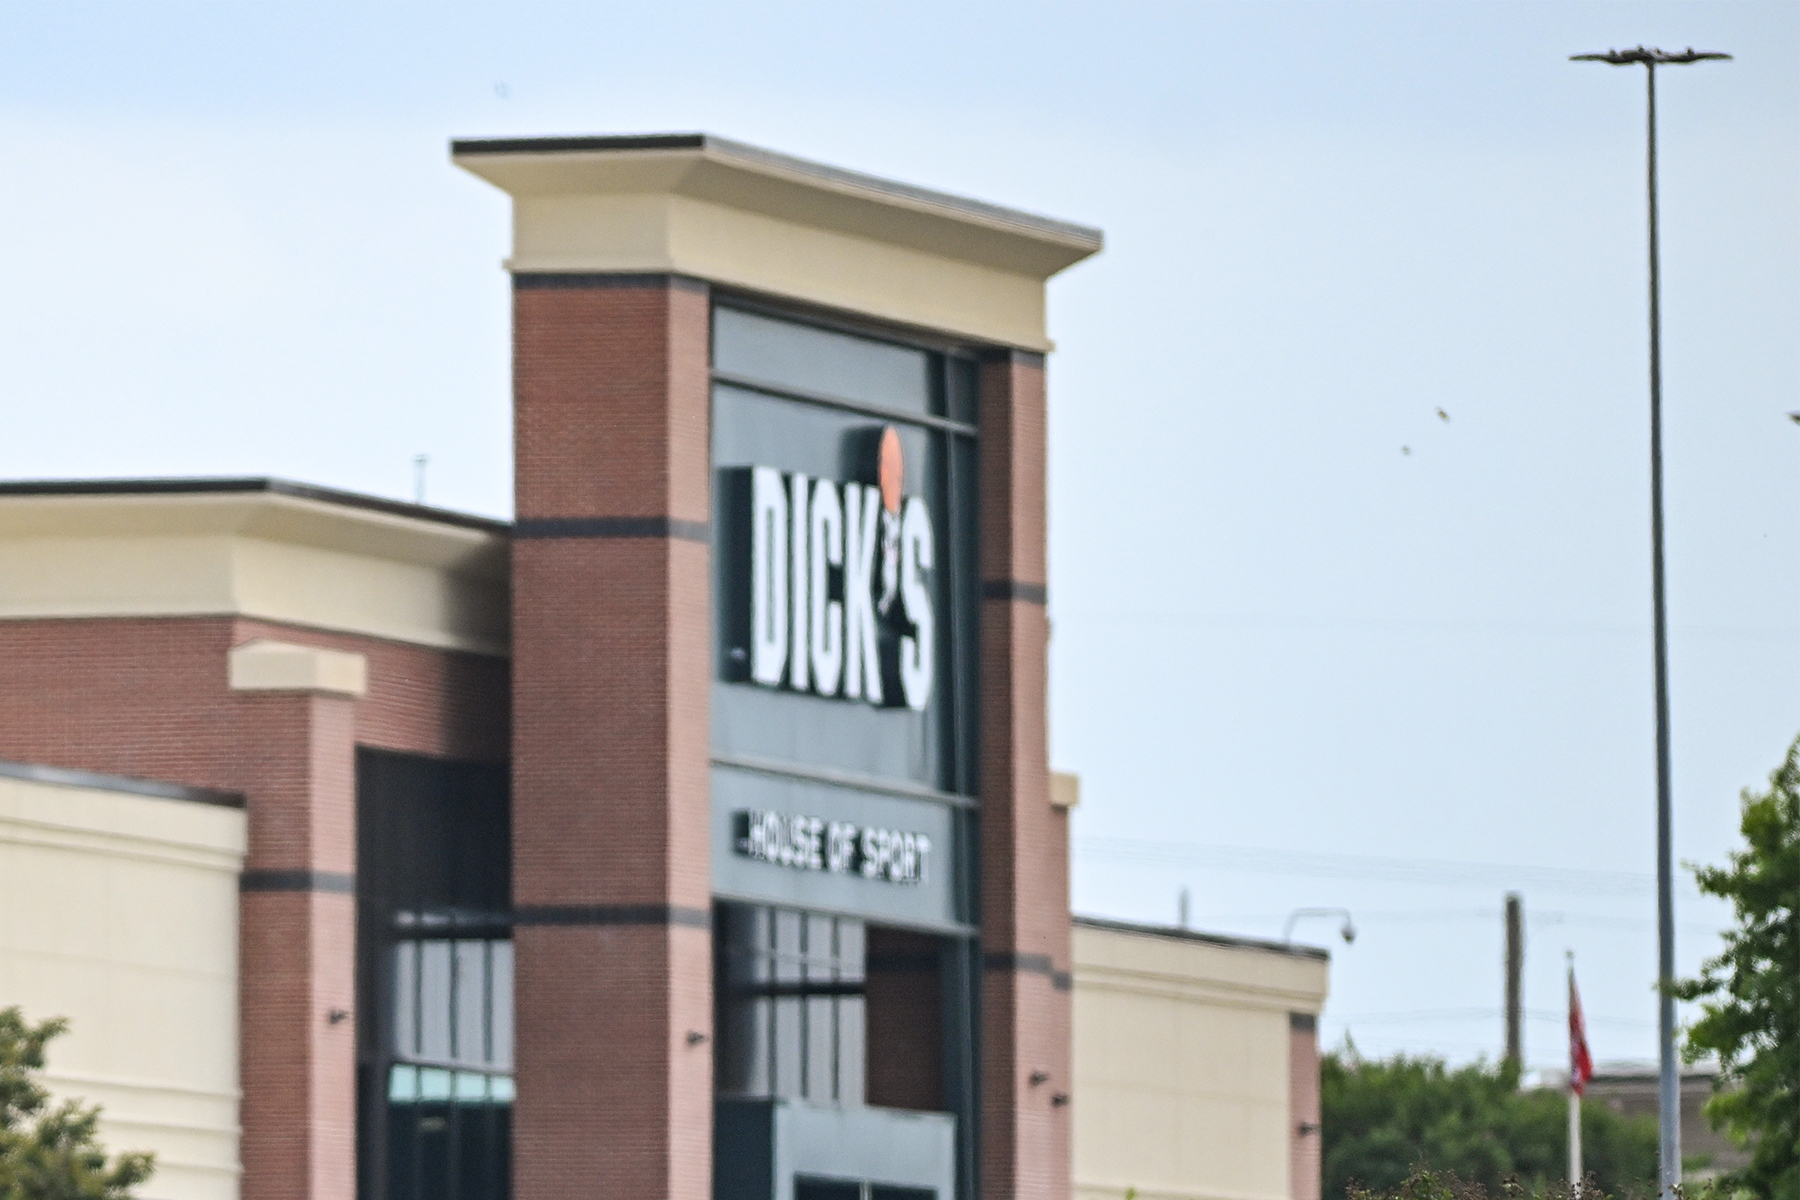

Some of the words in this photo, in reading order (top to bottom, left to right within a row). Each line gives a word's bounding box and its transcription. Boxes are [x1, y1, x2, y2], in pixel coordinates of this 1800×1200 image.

[751, 425, 936, 711] DICK'S
[750, 808, 823, 870] HOUSE
[827, 822, 856, 874] OF
[861, 827, 932, 885] SPORT
